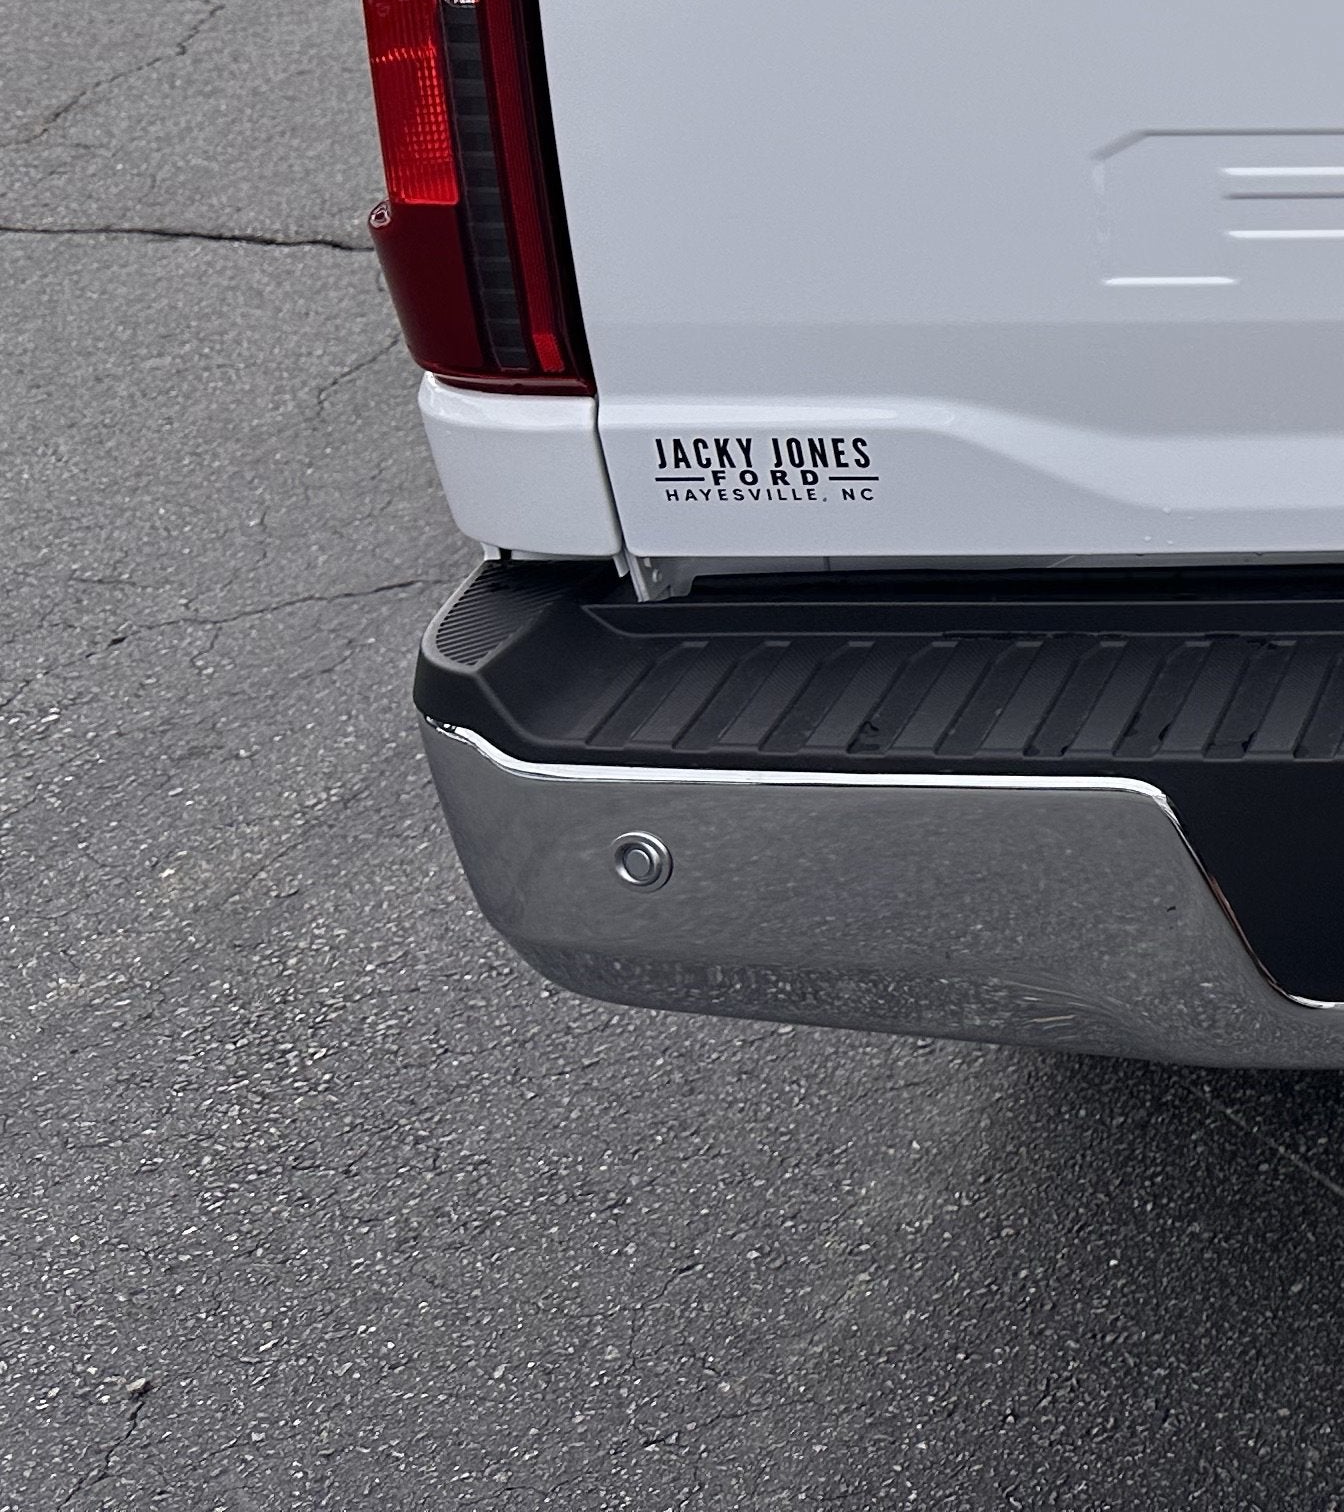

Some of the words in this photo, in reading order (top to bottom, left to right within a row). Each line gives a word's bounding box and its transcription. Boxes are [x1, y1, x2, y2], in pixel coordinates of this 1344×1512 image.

[655, 437, 753, 469] JACKY
[772, 437, 871, 468] JONES
[711, 469, 819, 486] FORD
[842, 488, 875, 501] NC
